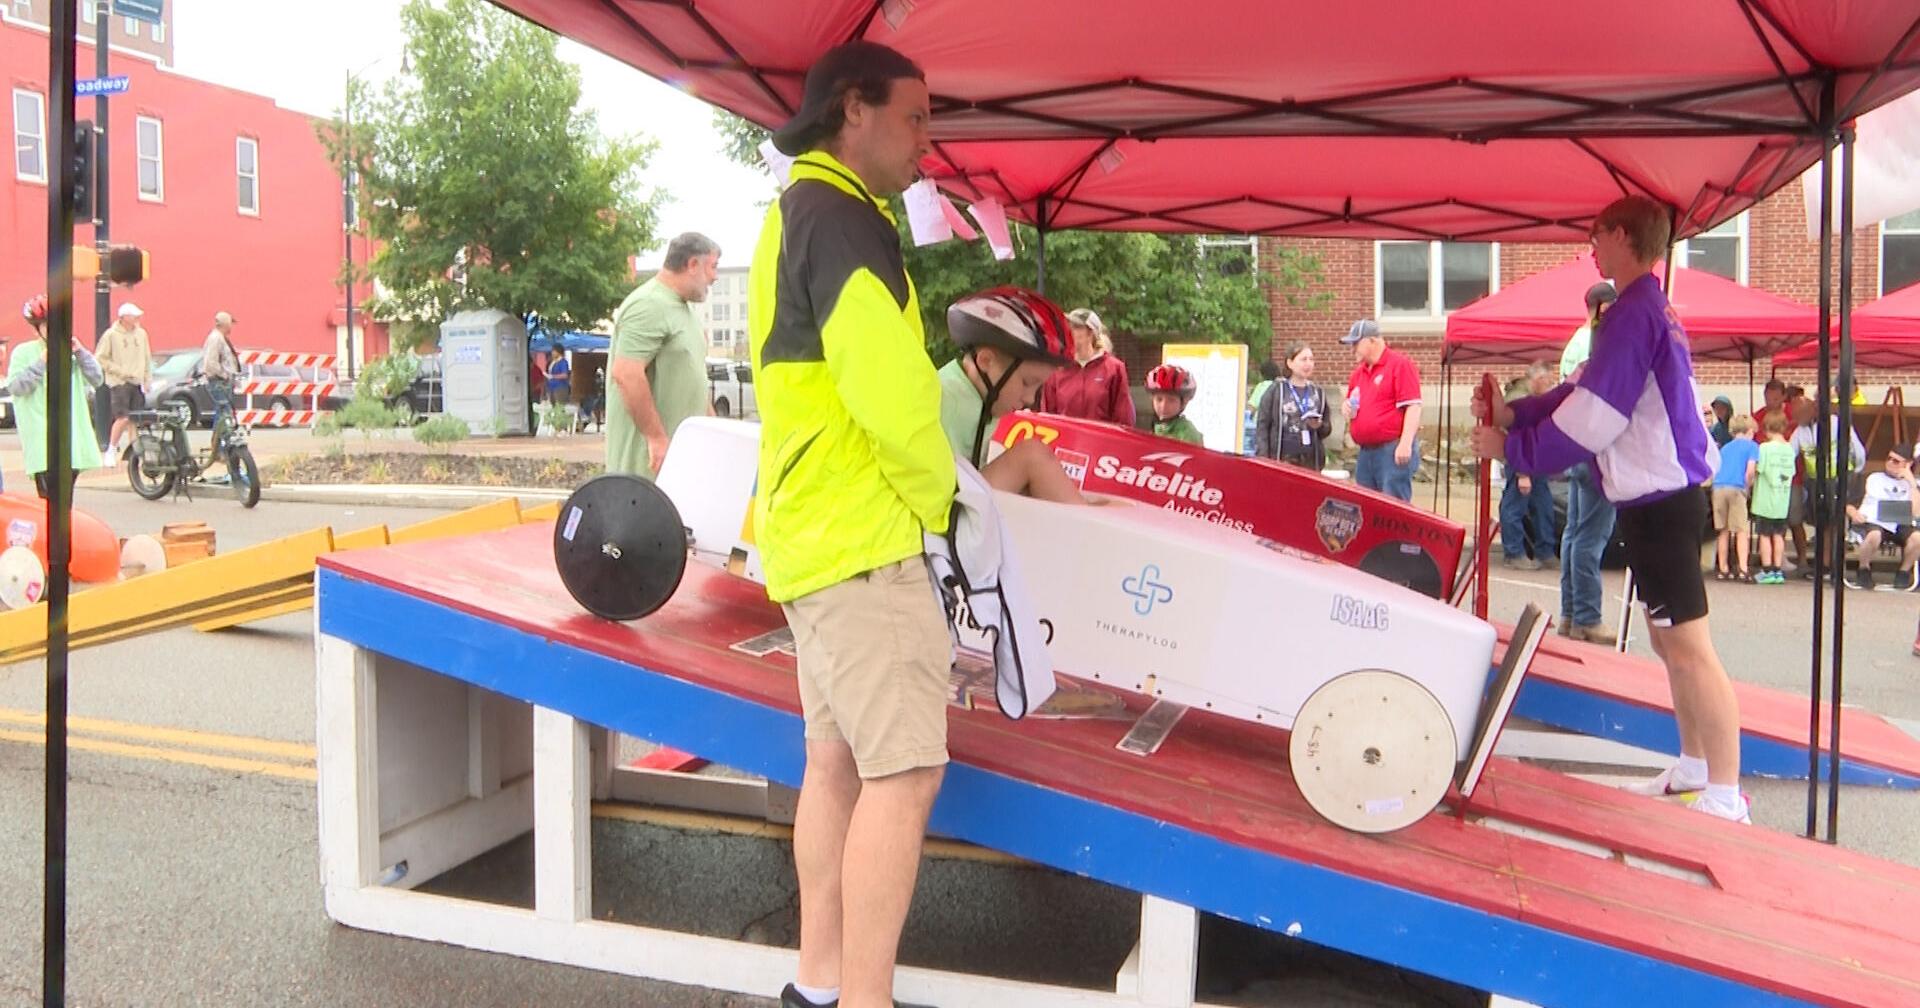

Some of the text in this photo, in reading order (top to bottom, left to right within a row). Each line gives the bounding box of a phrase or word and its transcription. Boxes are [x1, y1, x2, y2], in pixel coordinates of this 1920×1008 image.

[77, 78, 128, 93] oadway
[1093, 455, 1223, 505] Safelite
[1163, 500, 1254, 534] AutoGlass
[1373, 513, 1459, 547] BOSTON
[1330, 594, 1389, 631] ISAAC
[1096, 620, 1177, 649] THERAPYLOG
